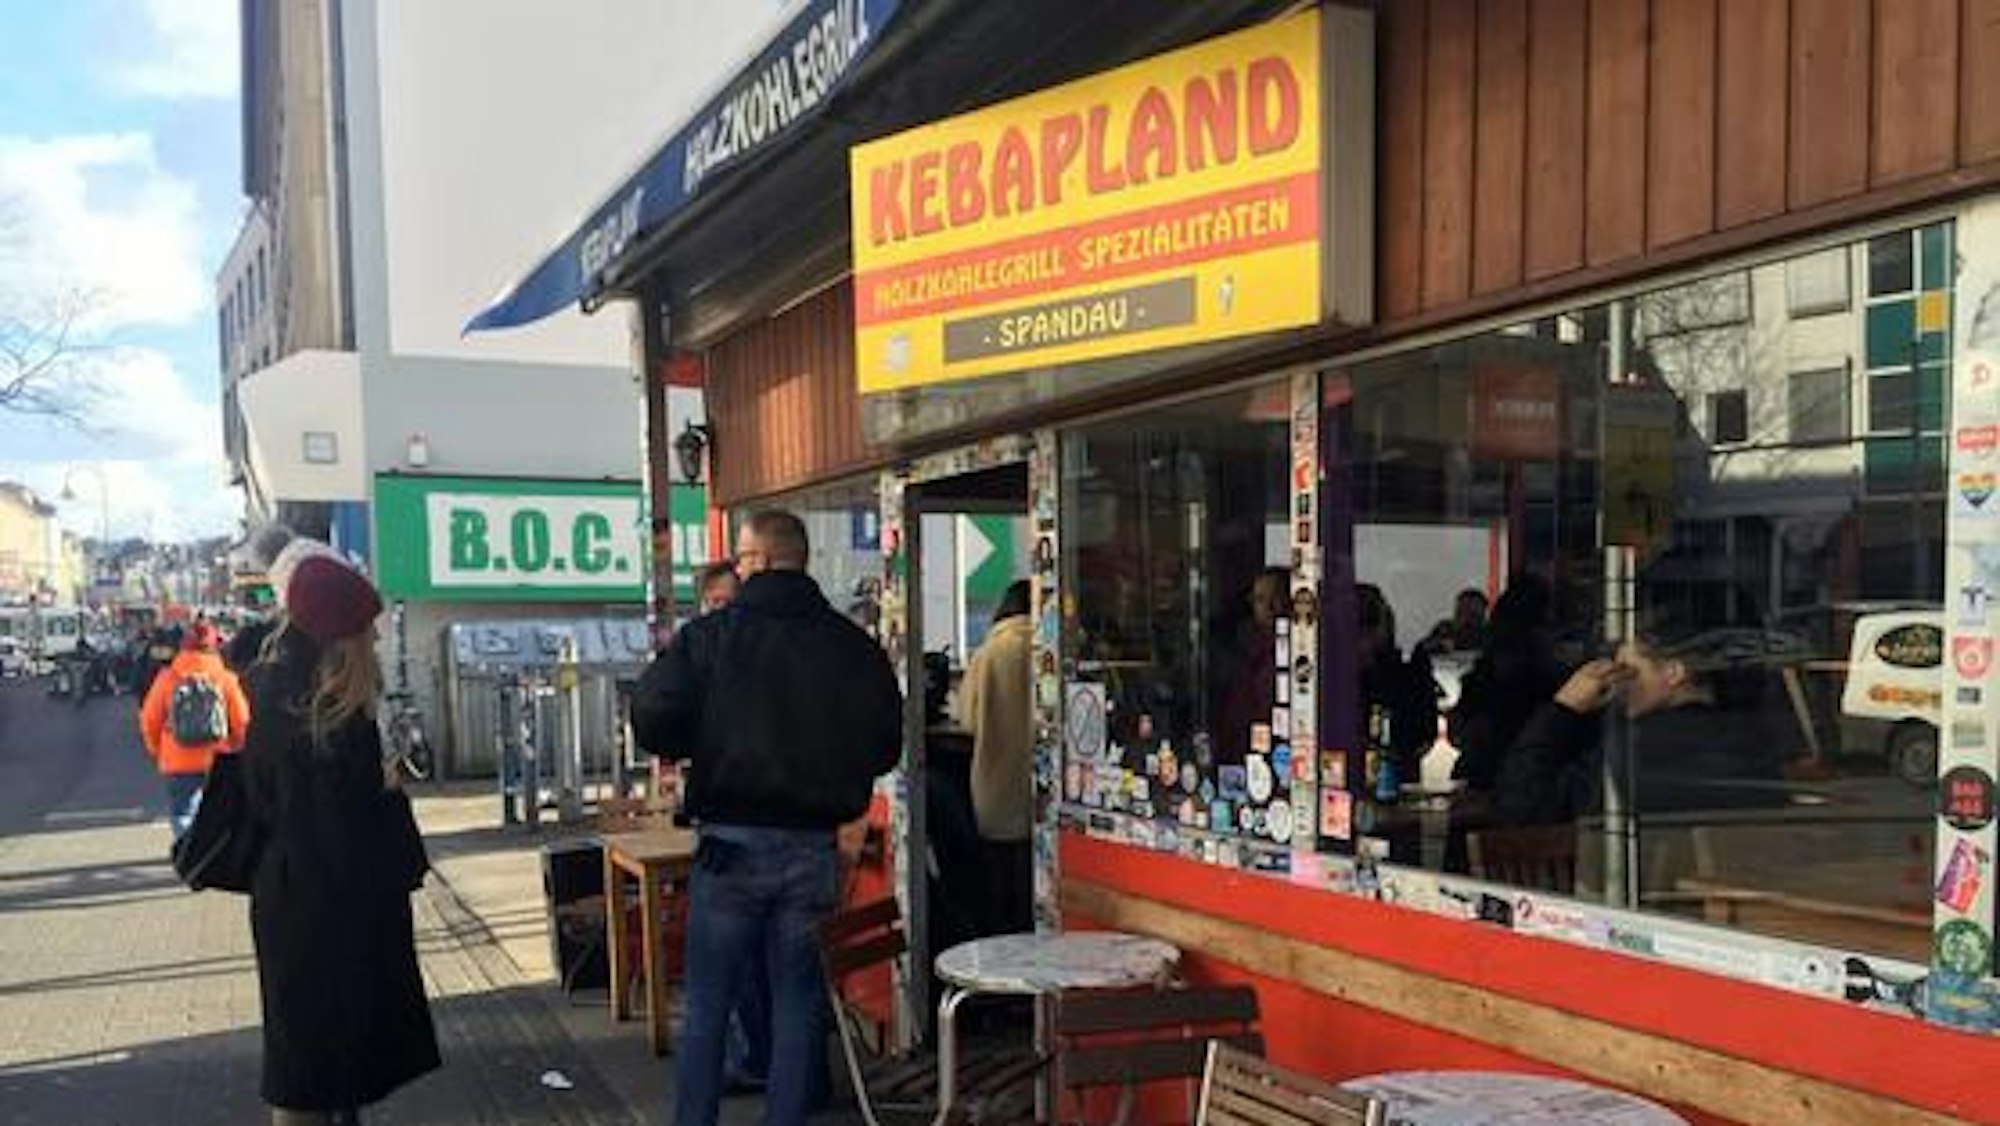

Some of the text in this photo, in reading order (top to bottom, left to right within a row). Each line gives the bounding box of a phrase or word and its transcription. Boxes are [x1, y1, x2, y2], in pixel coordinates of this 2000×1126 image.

[867, 57, 1300, 246] KEBAPLAND
[873, 245, 1066, 317] HOLZKOHLEGRILL
[999, 298, 1128, 348] SPANDAU
[449, 508, 629, 573] B.O.C.
